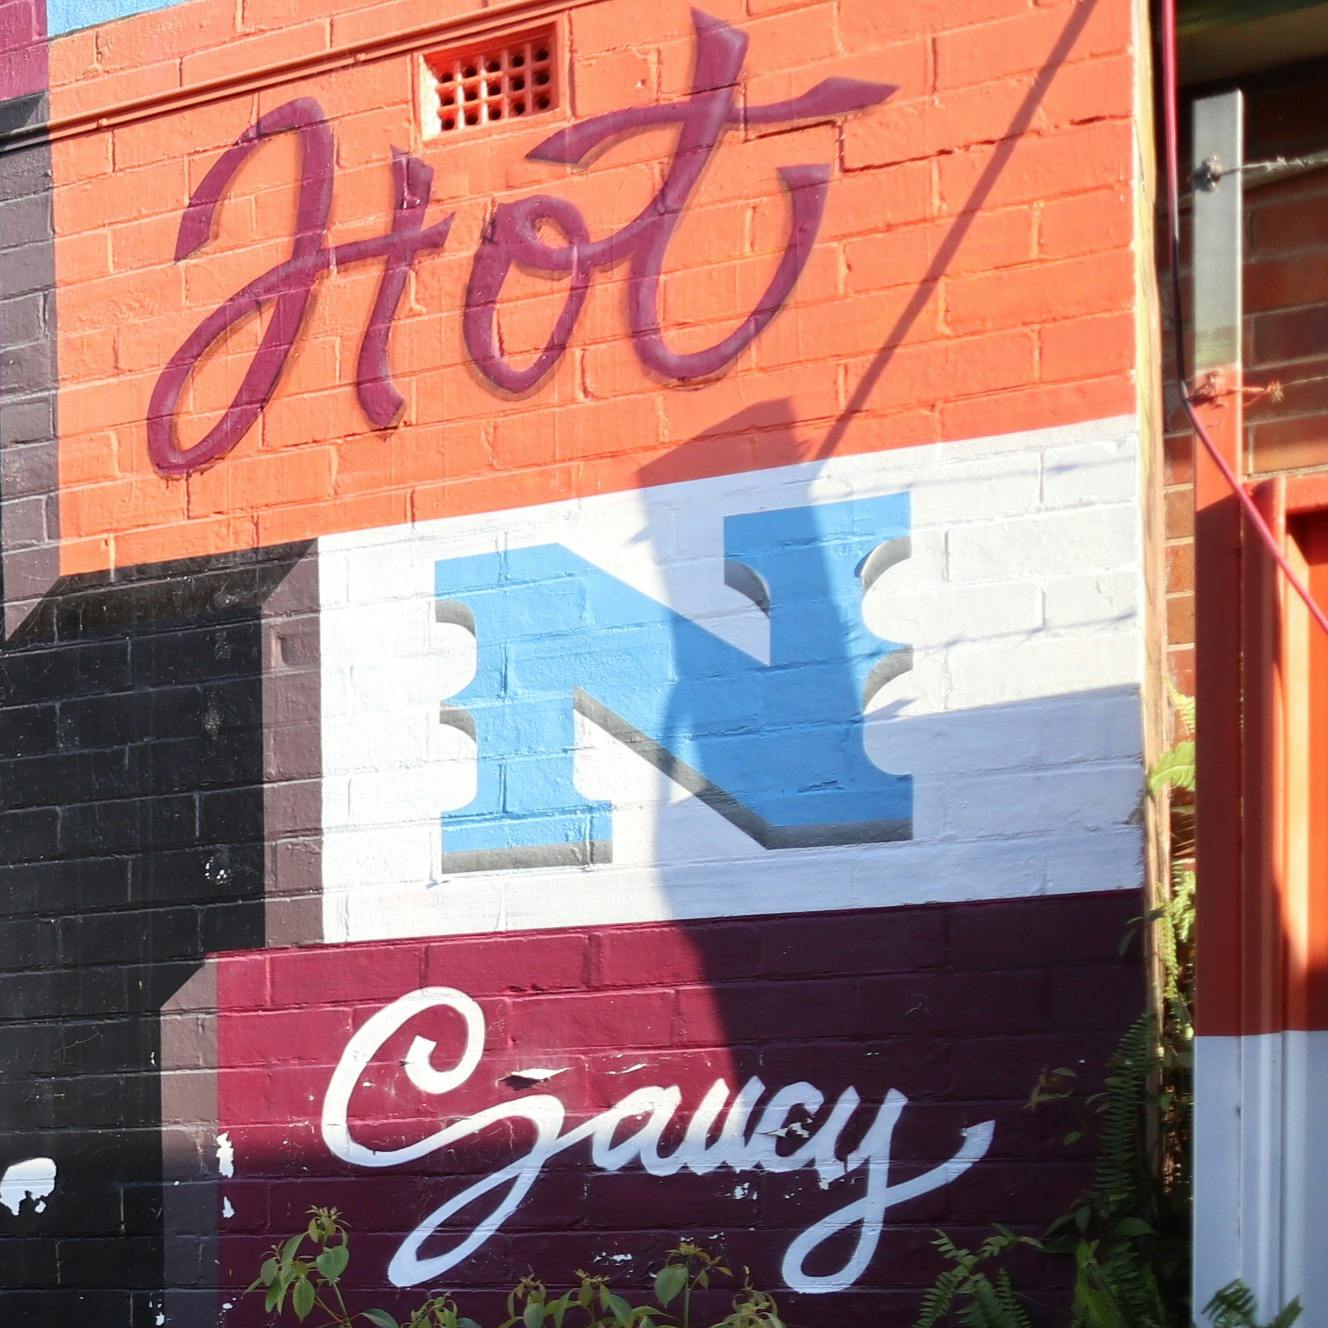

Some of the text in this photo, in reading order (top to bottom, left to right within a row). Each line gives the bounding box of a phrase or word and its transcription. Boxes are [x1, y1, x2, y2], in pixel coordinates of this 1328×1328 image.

[147, 7, 900, 479] Hot
[434, 492, 914, 874] N
[323, 986, 994, 1294] Saucy
